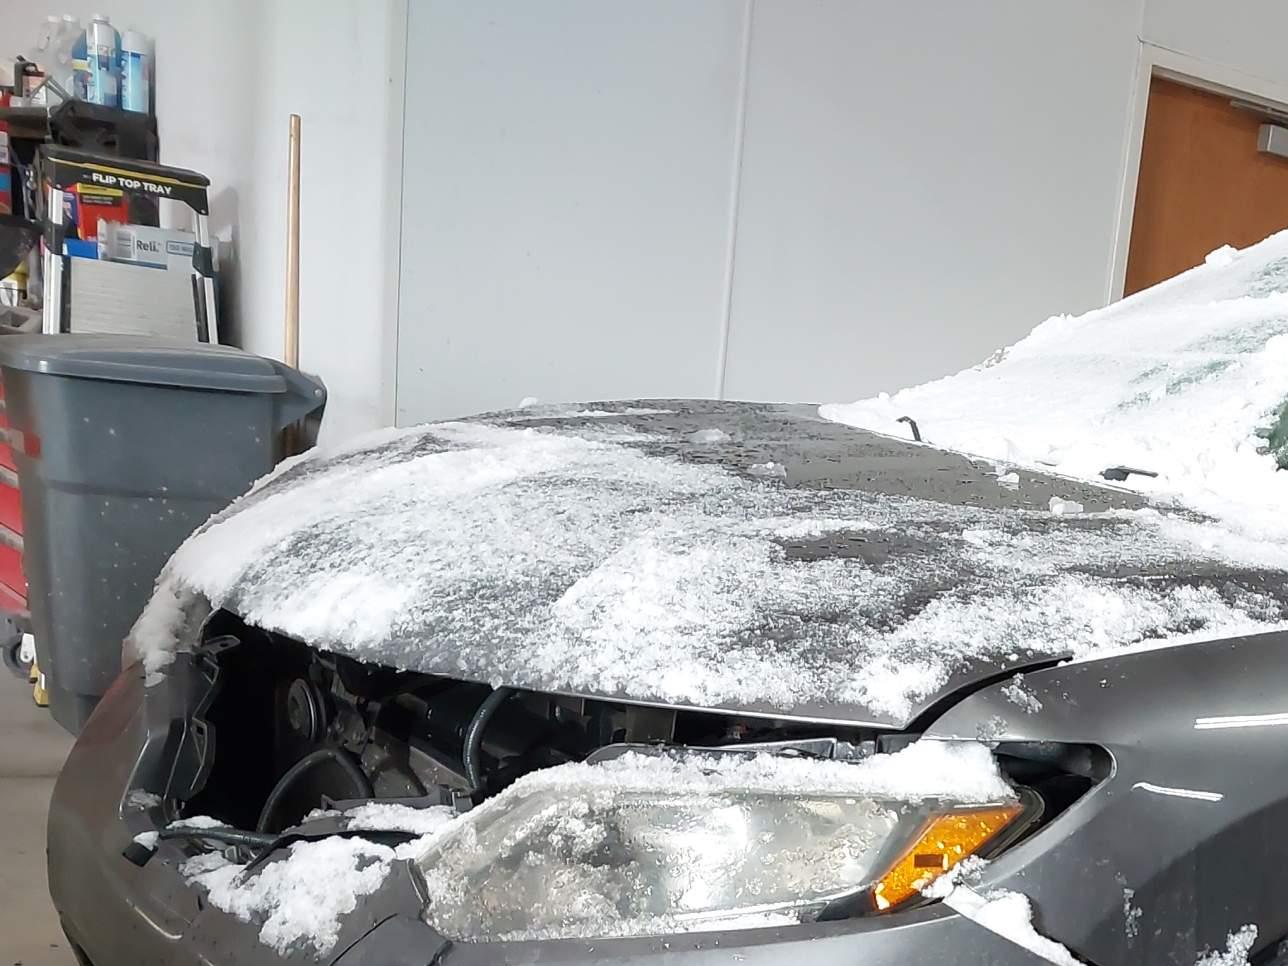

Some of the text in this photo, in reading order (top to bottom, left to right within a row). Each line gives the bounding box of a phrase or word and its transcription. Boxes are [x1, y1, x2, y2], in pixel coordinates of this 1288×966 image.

[92, 172, 116, 184] FLIP
[118, 177, 140, 189] TOP
[142, 181, 172, 195] TRAY
